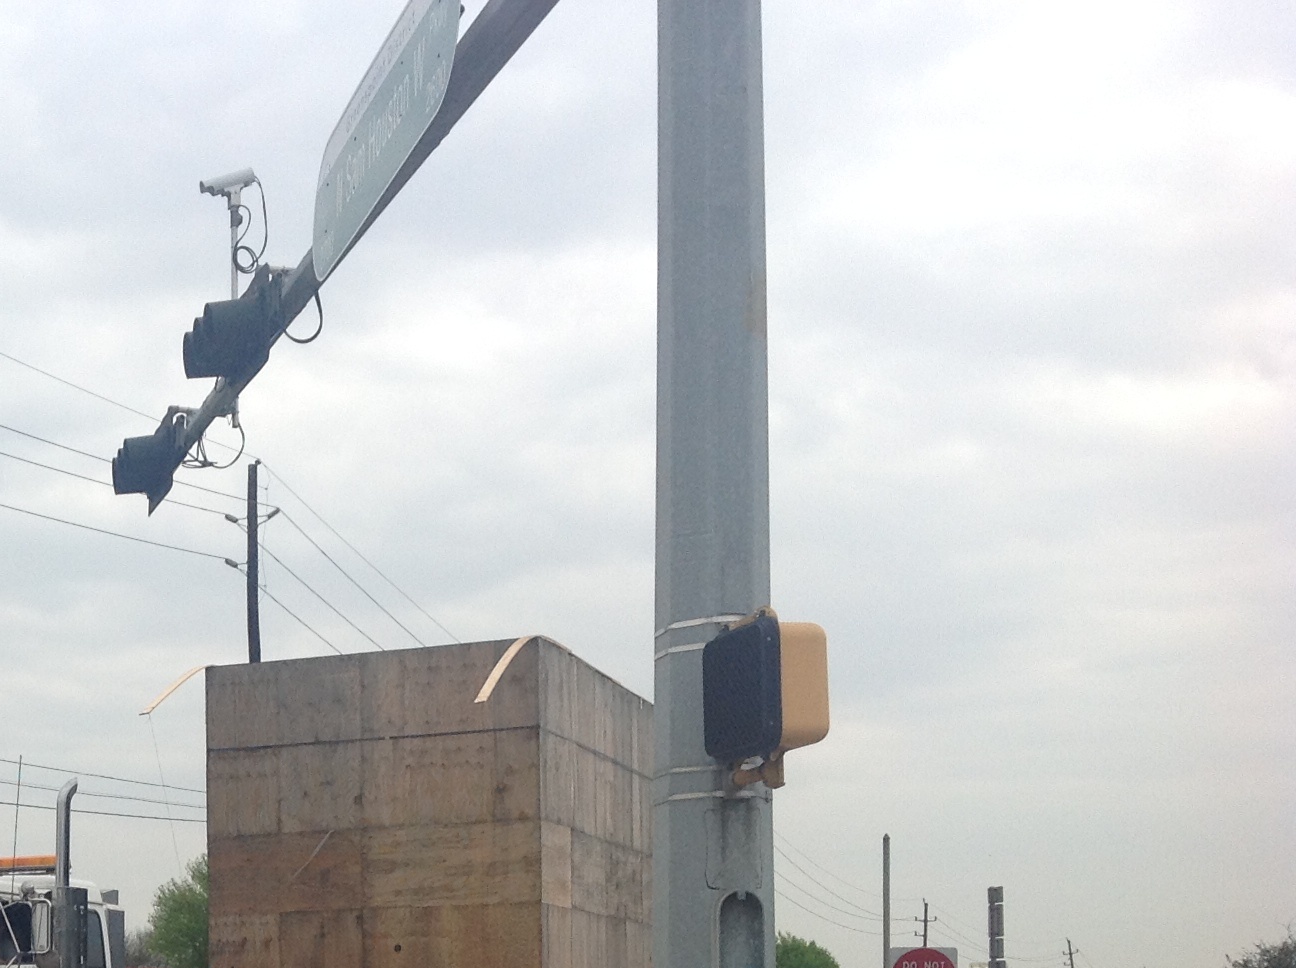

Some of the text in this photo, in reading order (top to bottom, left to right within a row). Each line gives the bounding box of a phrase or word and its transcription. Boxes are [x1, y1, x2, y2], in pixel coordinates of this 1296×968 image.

[346, 144, 365, 202] Sam
[368, 74, 409, 168] Houston
[413, 37, 425, 96] W
